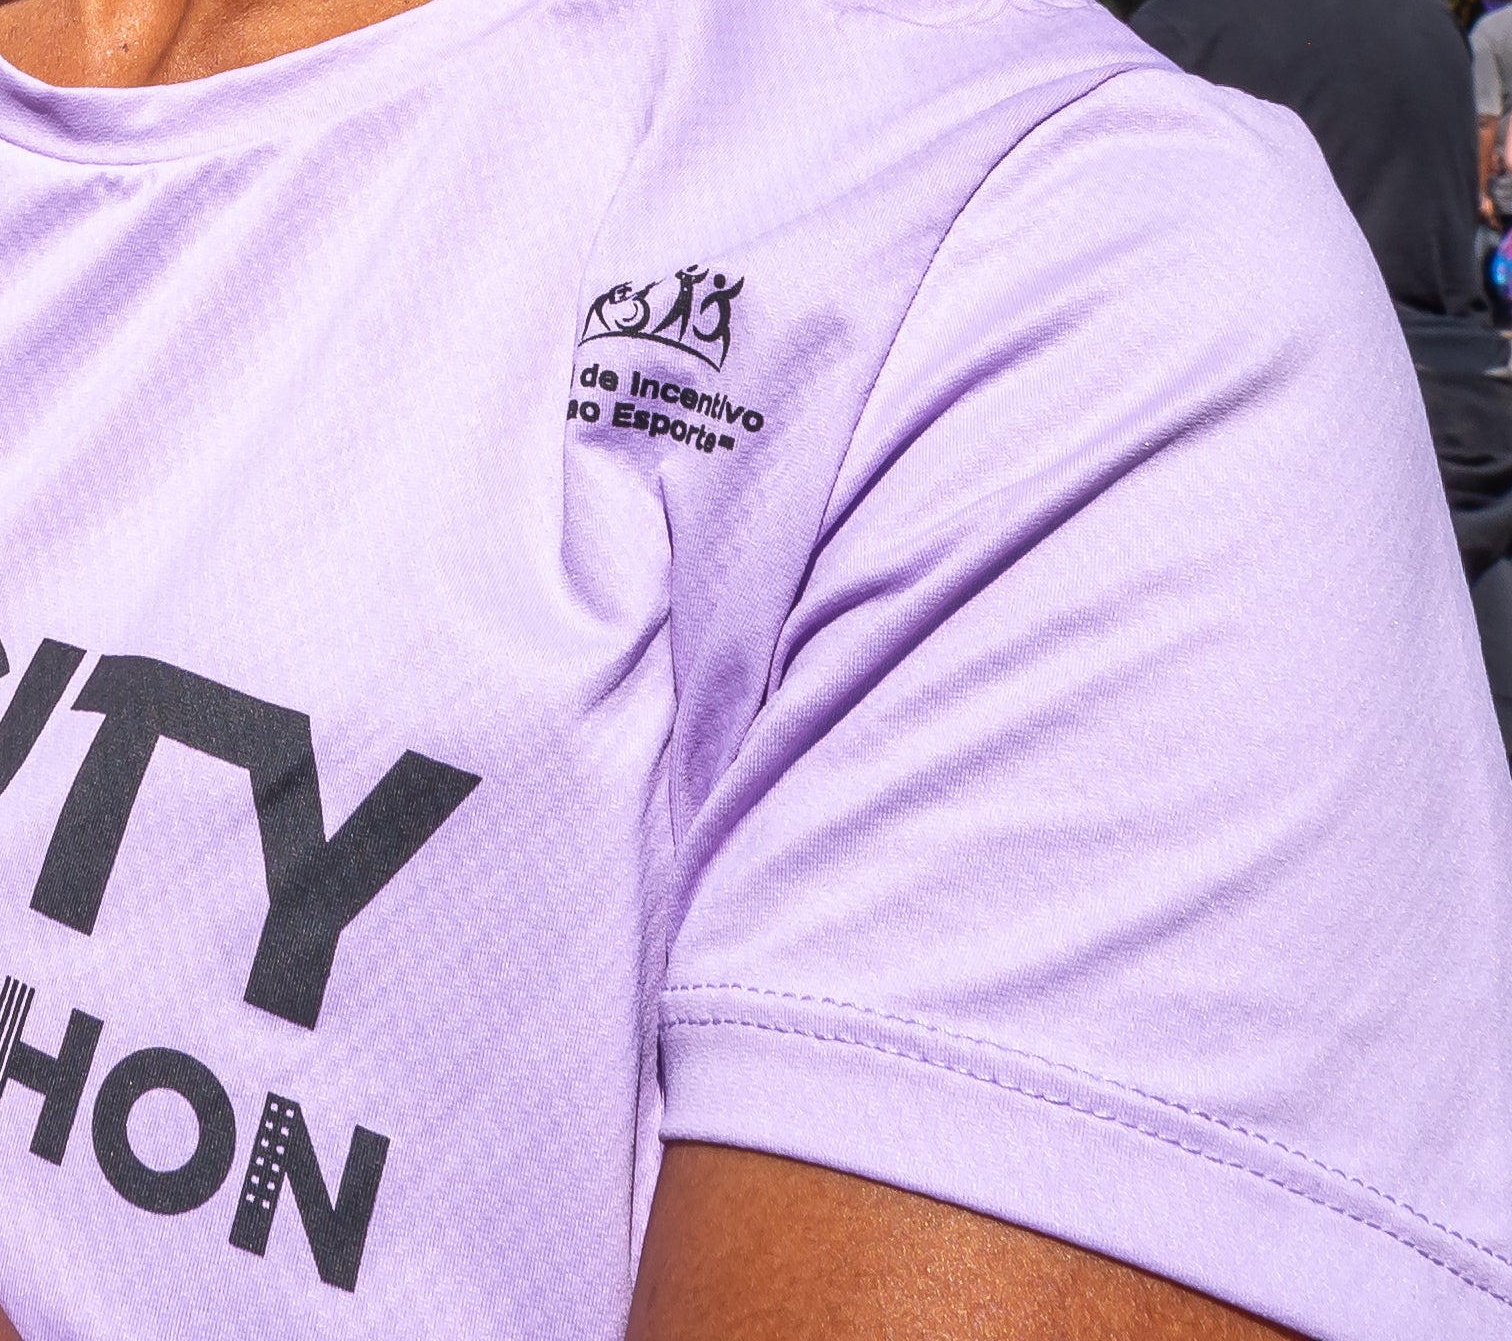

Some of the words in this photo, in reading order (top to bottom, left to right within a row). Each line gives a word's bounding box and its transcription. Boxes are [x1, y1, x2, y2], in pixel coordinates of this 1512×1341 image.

[579, 363, 619, 392] de
[630, 370, 765, 433] Incentivo
[611, 401, 717, 453] Esporte
